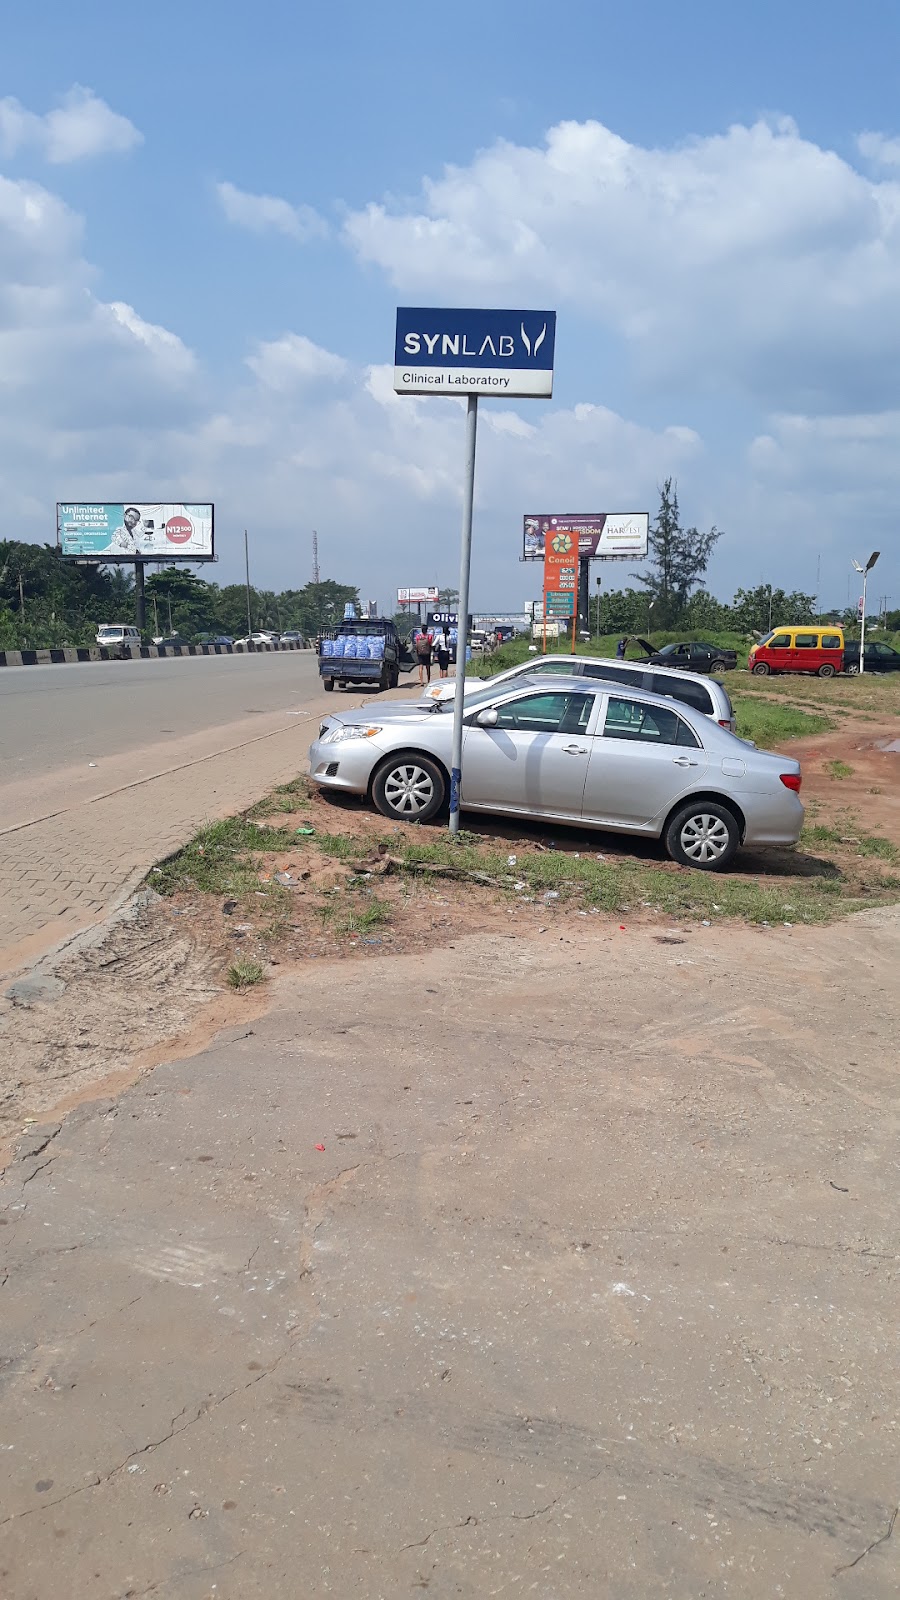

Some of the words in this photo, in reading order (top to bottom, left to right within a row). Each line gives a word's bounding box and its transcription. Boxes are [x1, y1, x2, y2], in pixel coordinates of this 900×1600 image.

[403, 332, 515, 357] SYNLAB
[402, 372, 445, 384] Clinical
[448, 374, 511, 388] Laboratory
[62, 506, 104, 514] Unlimited
[73, 513, 108, 521] Internet
[548, 555, 575, 564] Conoil
[433, 614, 458, 622] Olivi
